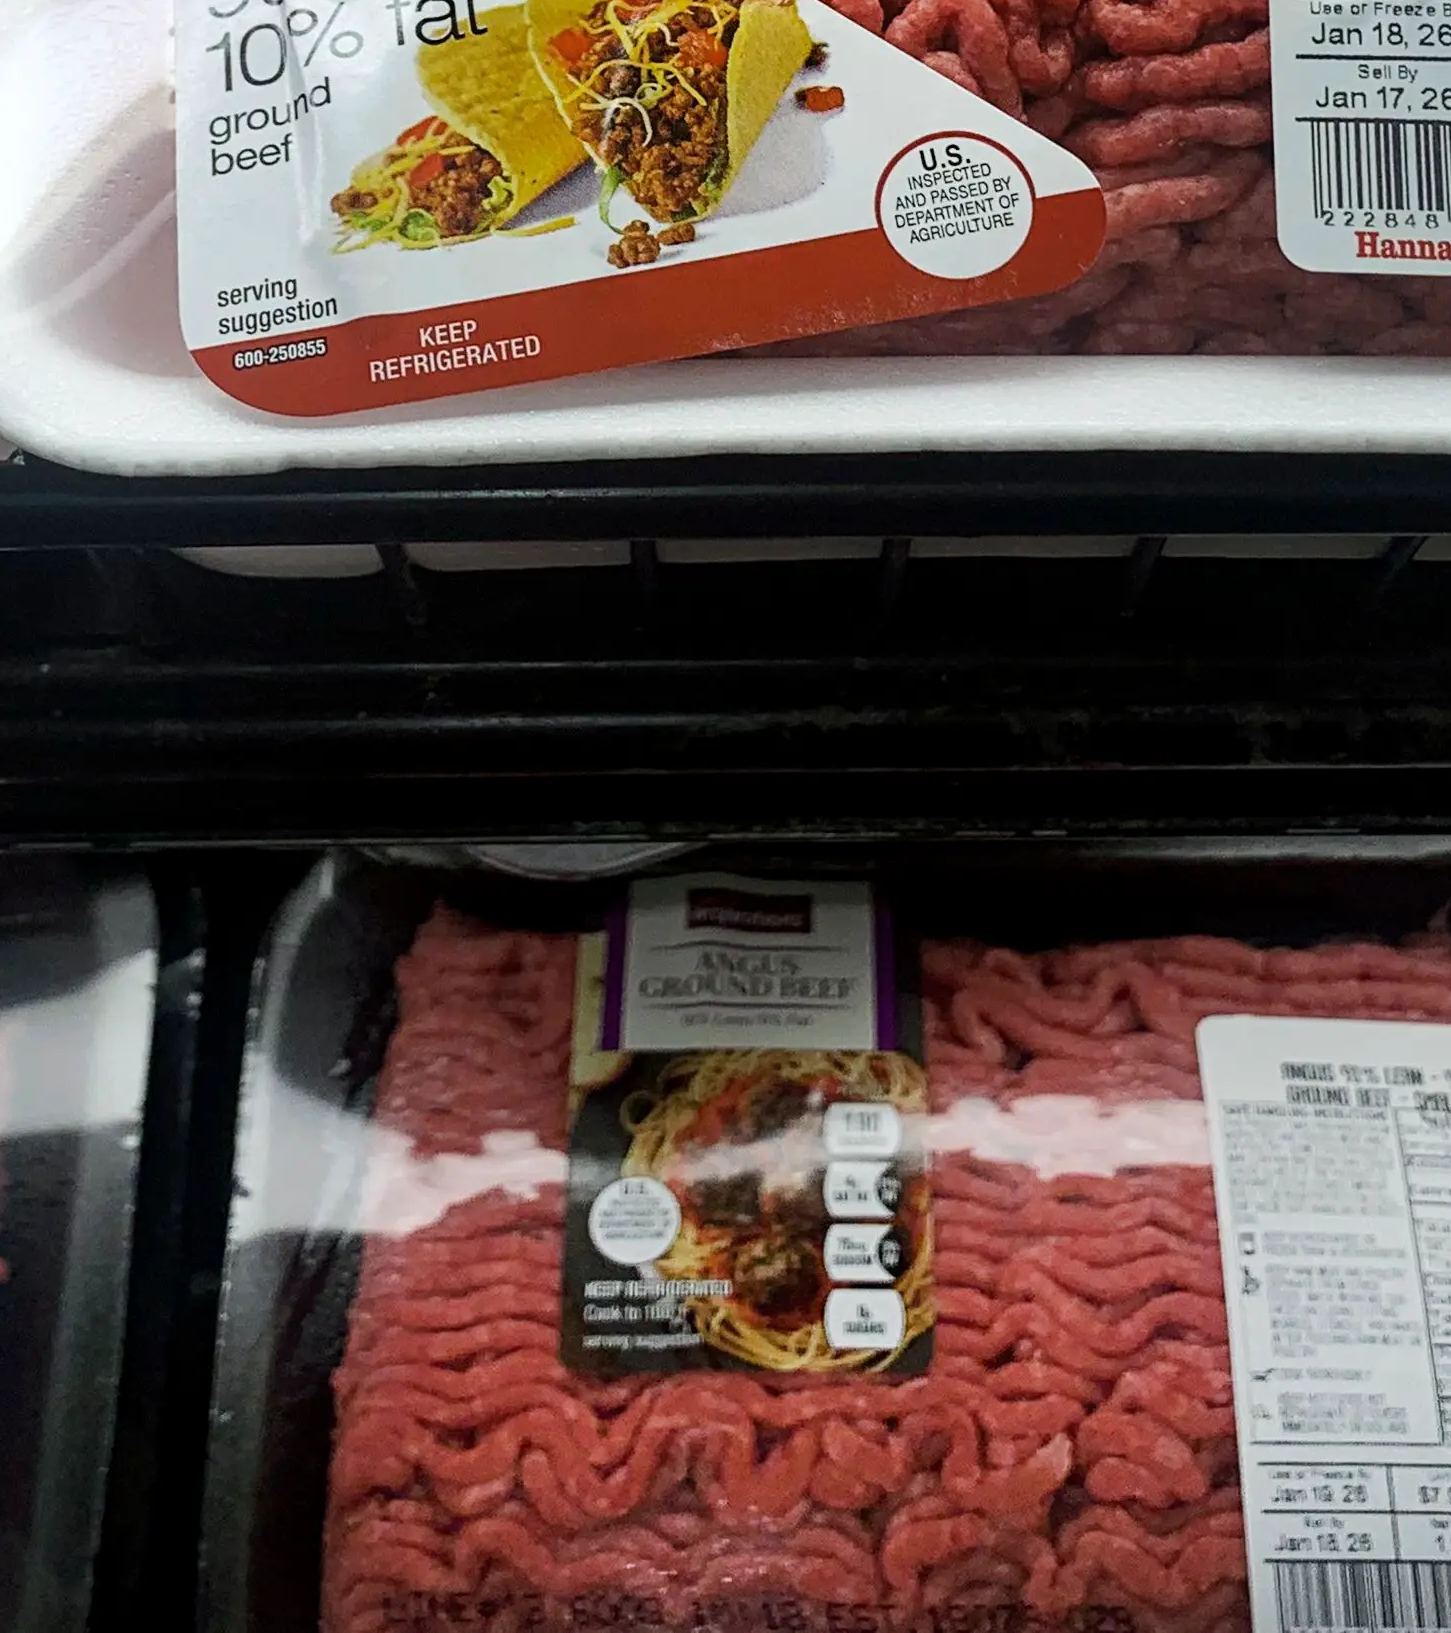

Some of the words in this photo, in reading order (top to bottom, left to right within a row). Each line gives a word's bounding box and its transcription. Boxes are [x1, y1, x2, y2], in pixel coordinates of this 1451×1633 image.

[1309, 2, 1340, 18] Use
[1310, 22, 1365, 48] Jan
[1373, 24, 1412, 49] 18,
[208, 77, 333, 148] ground
[1315, 87, 1369, 111] Jan
[1377, 87, 1419, 113] 17,
[210, 136, 295, 178] beef
[919, 144, 971, 171] U.S.
[908, 163, 991, 190] INSPECTED
[896, 194, 926, 211] AND
[930, 182, 989, 204] PASSED
[994, 176, 1011, 192] BY
[896, 198, 993, 229] DEPARTMENT
[999, 194, 1020, 209] OF
[910, 212, 1014, 244] AGRICULTURE
[217, 276, 300, 310] serving
[217, 293, 340, 337] suggestion
[418, 320, 480, 349] KEEP
[232, 338, 330, 368] 600-250855
[369, 334, 543, 385] REFRIGERATED
[638, 976, 772, 998] GROUND
